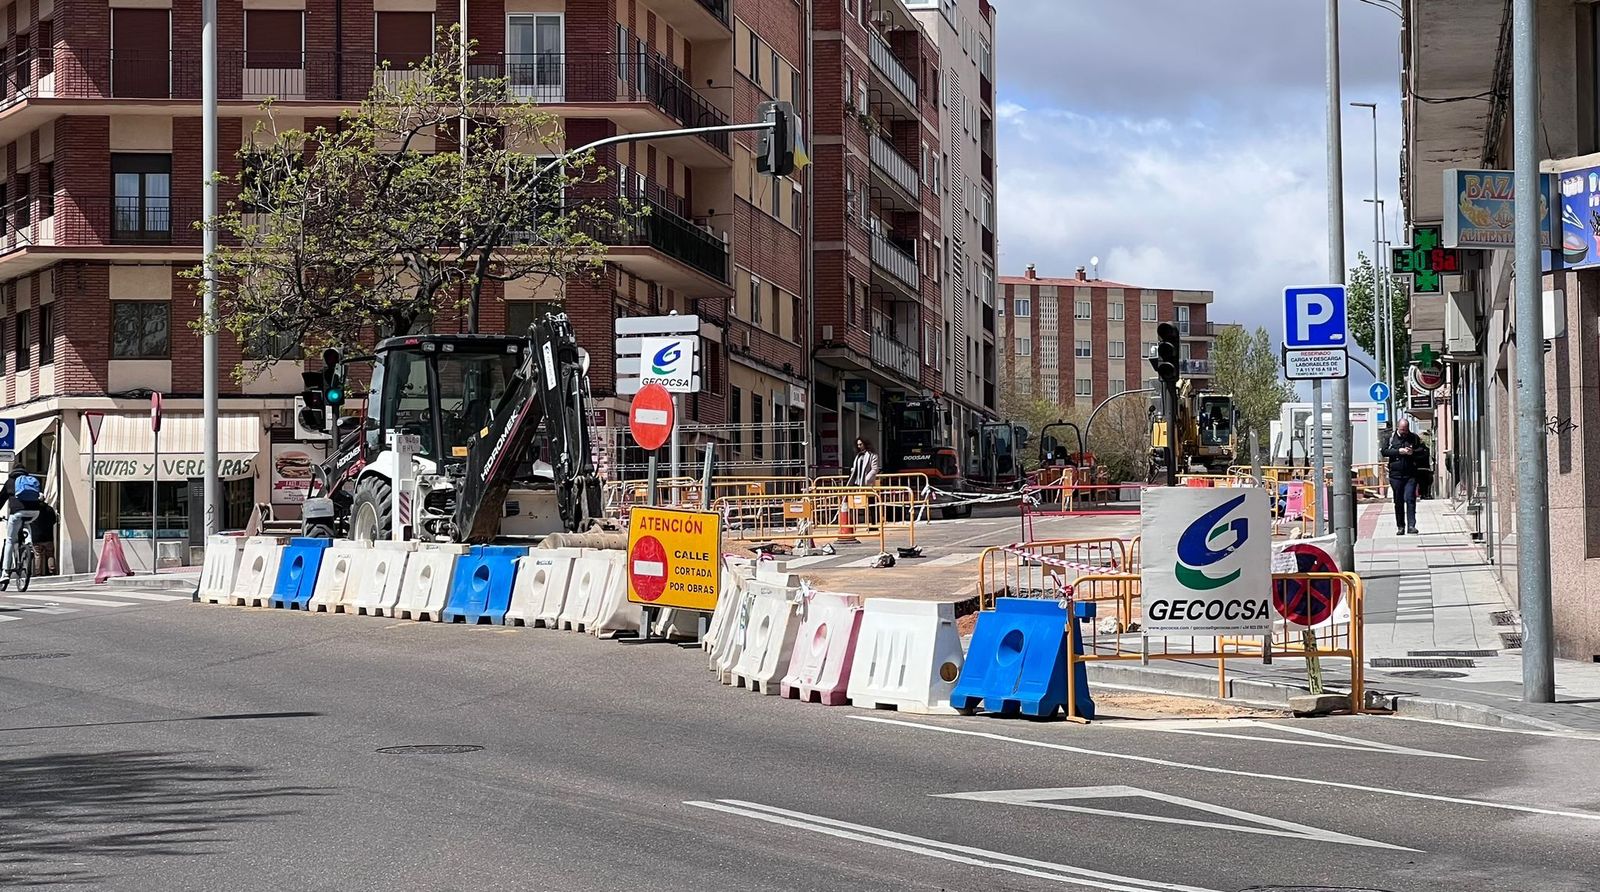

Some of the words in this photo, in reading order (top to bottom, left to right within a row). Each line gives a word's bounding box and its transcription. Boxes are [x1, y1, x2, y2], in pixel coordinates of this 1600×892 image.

[1465, 174, 1515, 200] BAZ
[1460, 229, 1549, 245] ALIMENTN
[1296, 293, 1334, 341] P
[642, 377, 689, 387] GECOCSA
[87, 460, 138, 476] FRUTAS
[640, 515, 703, 534] ATENCIÓN
[674, 550, 709, 561] CALLE
[674, 566, 712, 578] CORTADA
[669, 582, 685, 592] POR
[687, 583, 714, 594] OBRAS
[1148, 599, 1270, 621] GECOCSA
